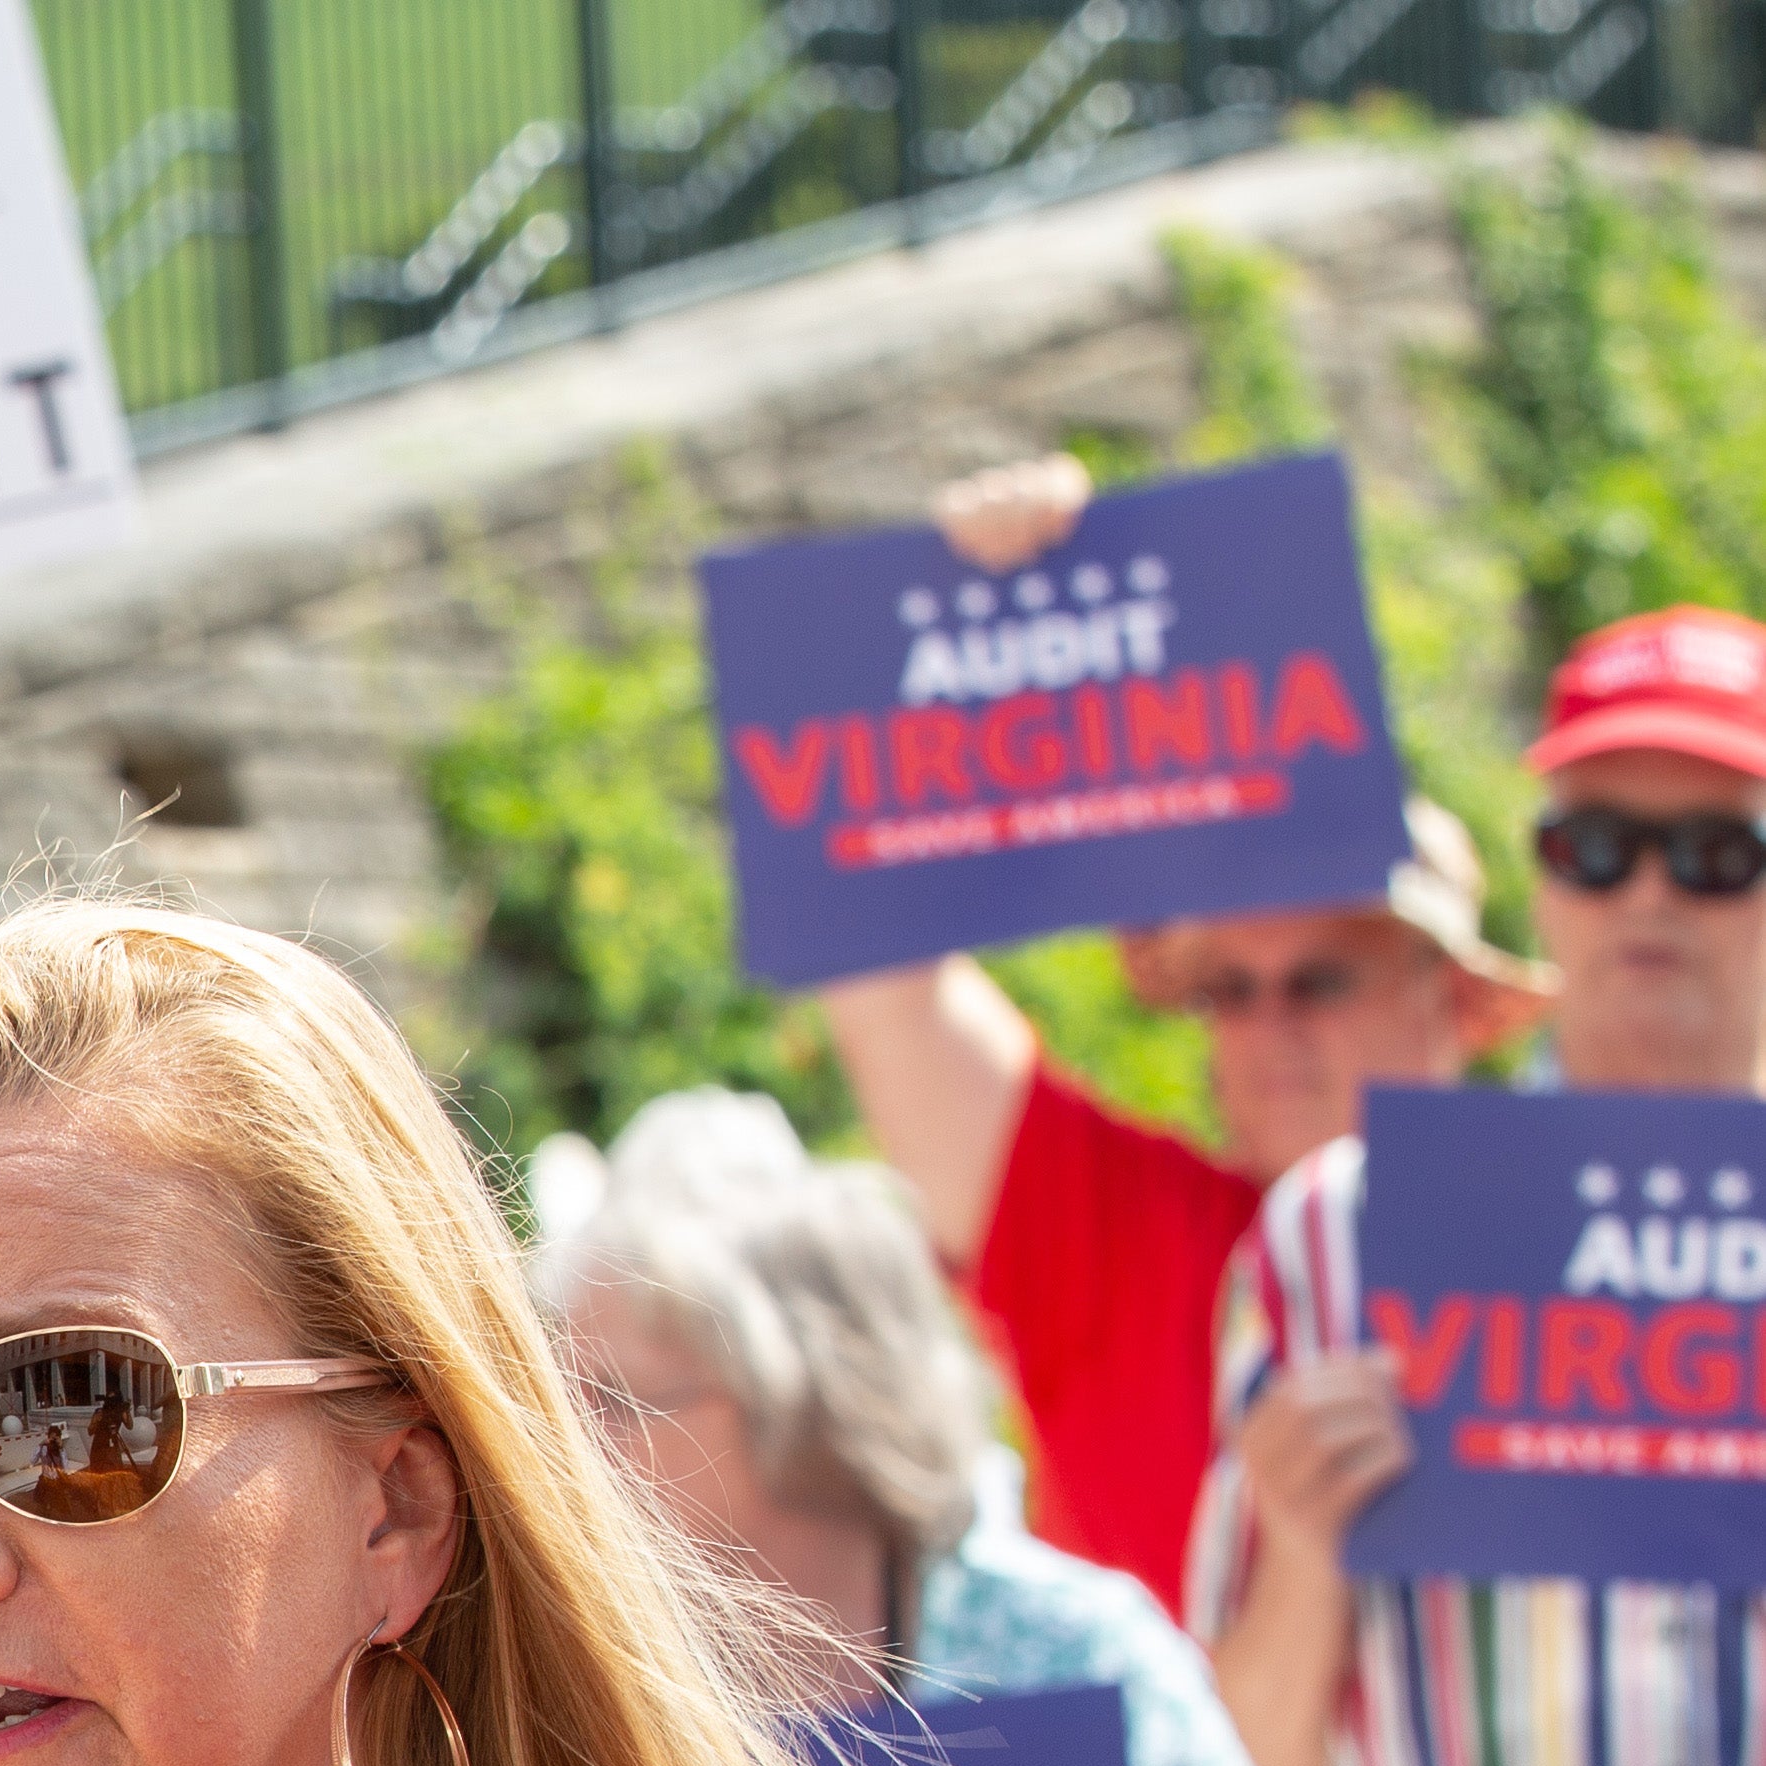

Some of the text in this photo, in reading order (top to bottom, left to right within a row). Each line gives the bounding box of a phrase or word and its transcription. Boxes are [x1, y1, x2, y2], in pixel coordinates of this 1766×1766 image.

[901, 600, 1173, 706] AUDIT
[736, 650, 1362, 825] VIRGINIA
[869, 774, 1238, 864] SAVE AMERICA
